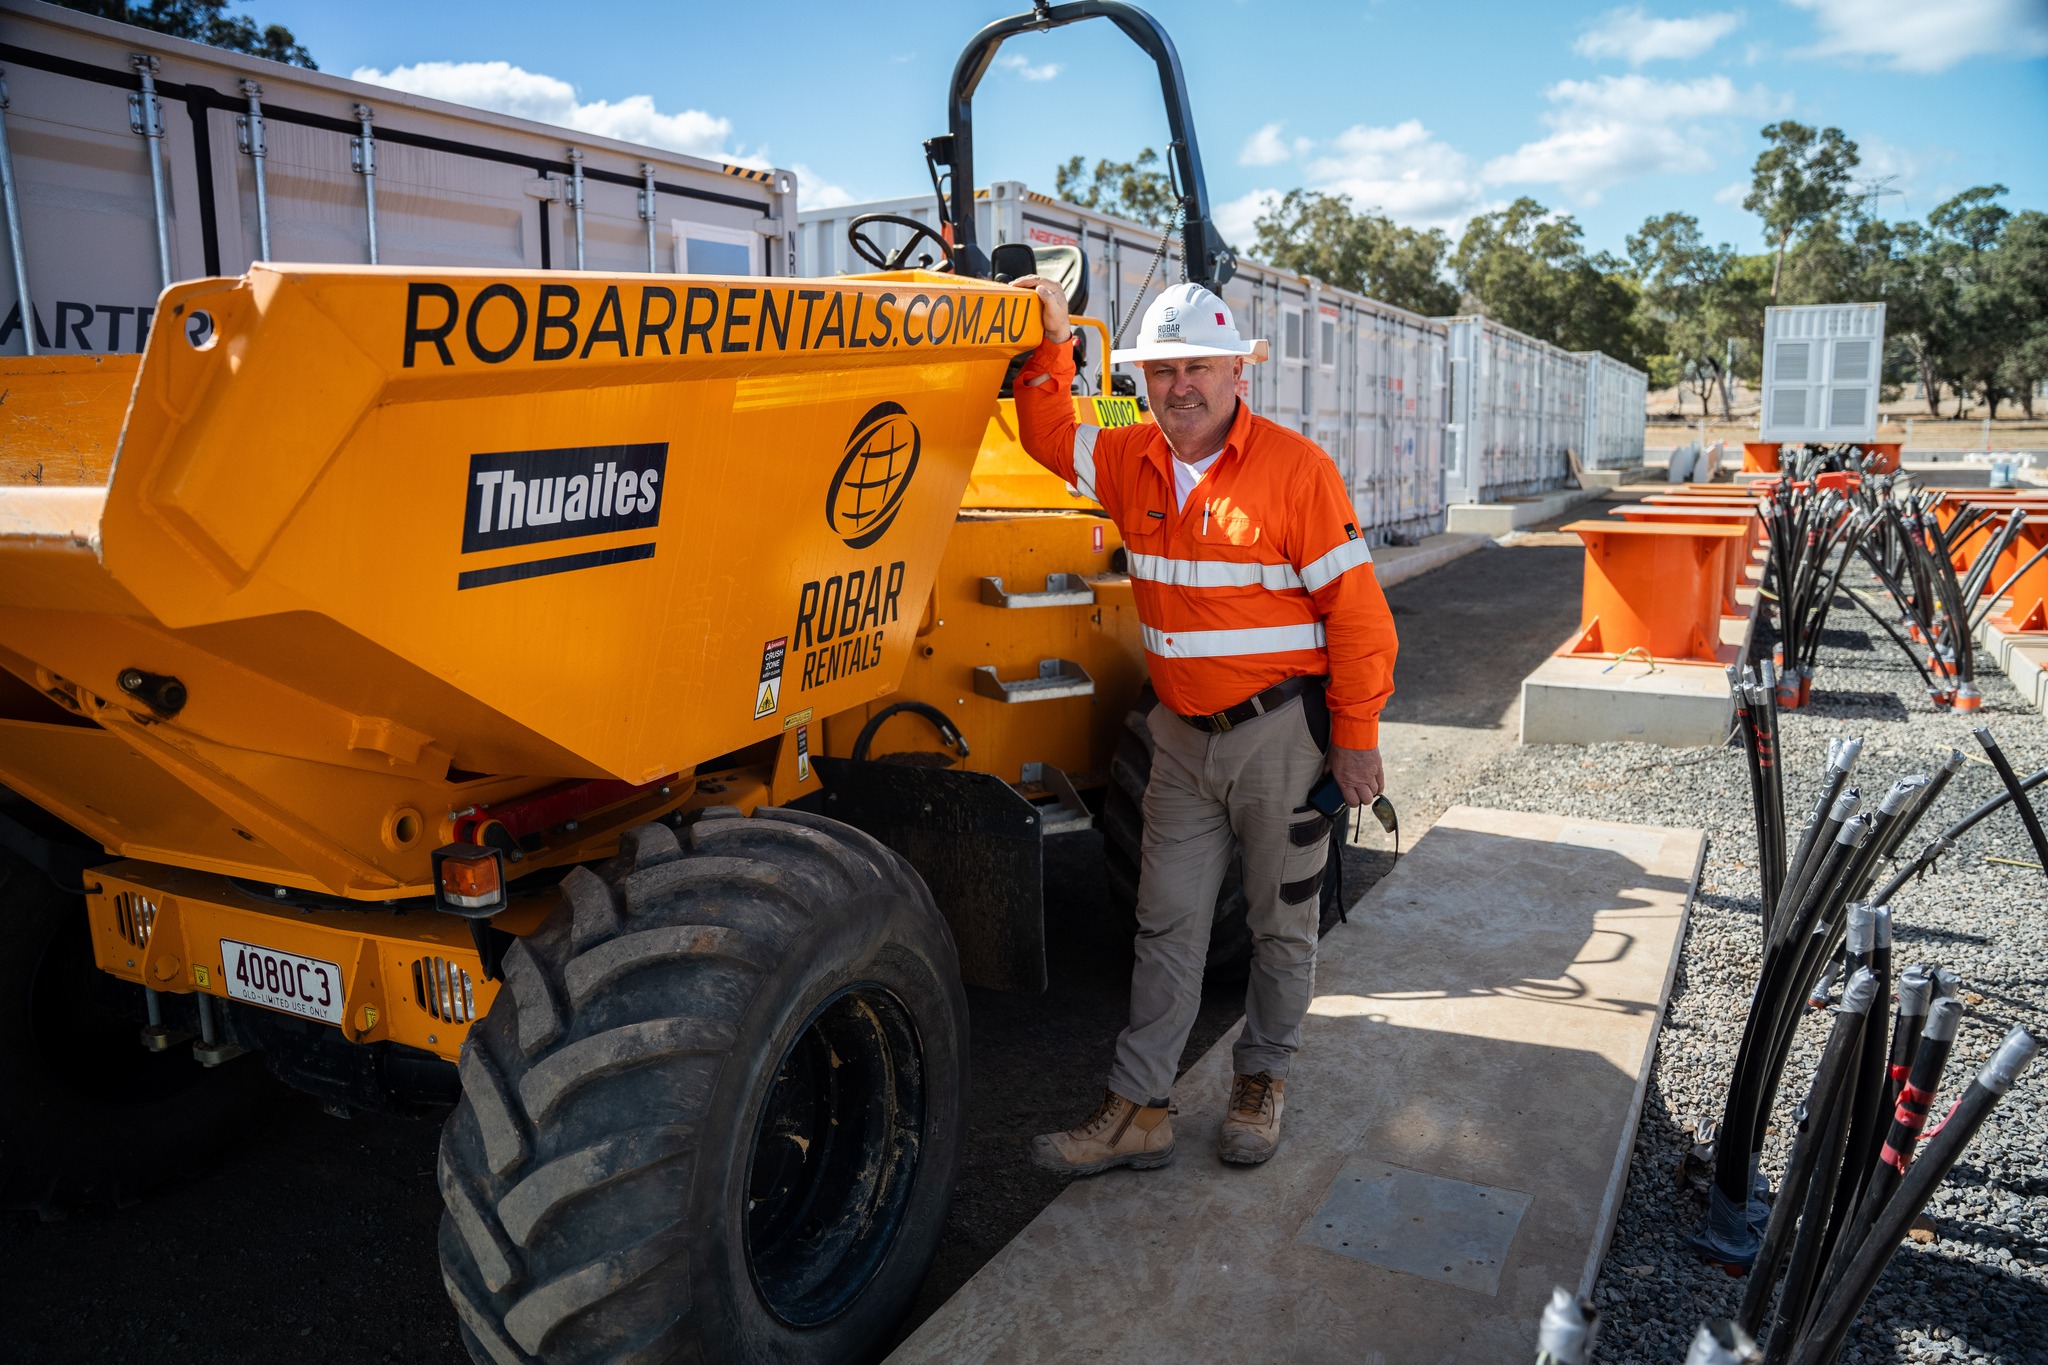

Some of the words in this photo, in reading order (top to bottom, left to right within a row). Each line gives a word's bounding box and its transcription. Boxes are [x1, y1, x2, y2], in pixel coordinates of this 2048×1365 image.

[402, 282, 1031, 368] ROBARRENTALS.COM.AU
[1157, 323, 1180, 333] ROBAR
[1096, 399, 1139, 427] DU002
[475, 461, 659, 533] Thwaites
[792, 561, 906, 653] ROBAR
[764, 648, 784, 661] CRUSH
[764, 659, 780, 671] ZONE
[800, 630, 884, 693] RENTALS
[236, 949, 331, 1007] 4080C3
[292, 1002, 307, 1014] USE
[309, 1006, 328, 1019] ONLY
